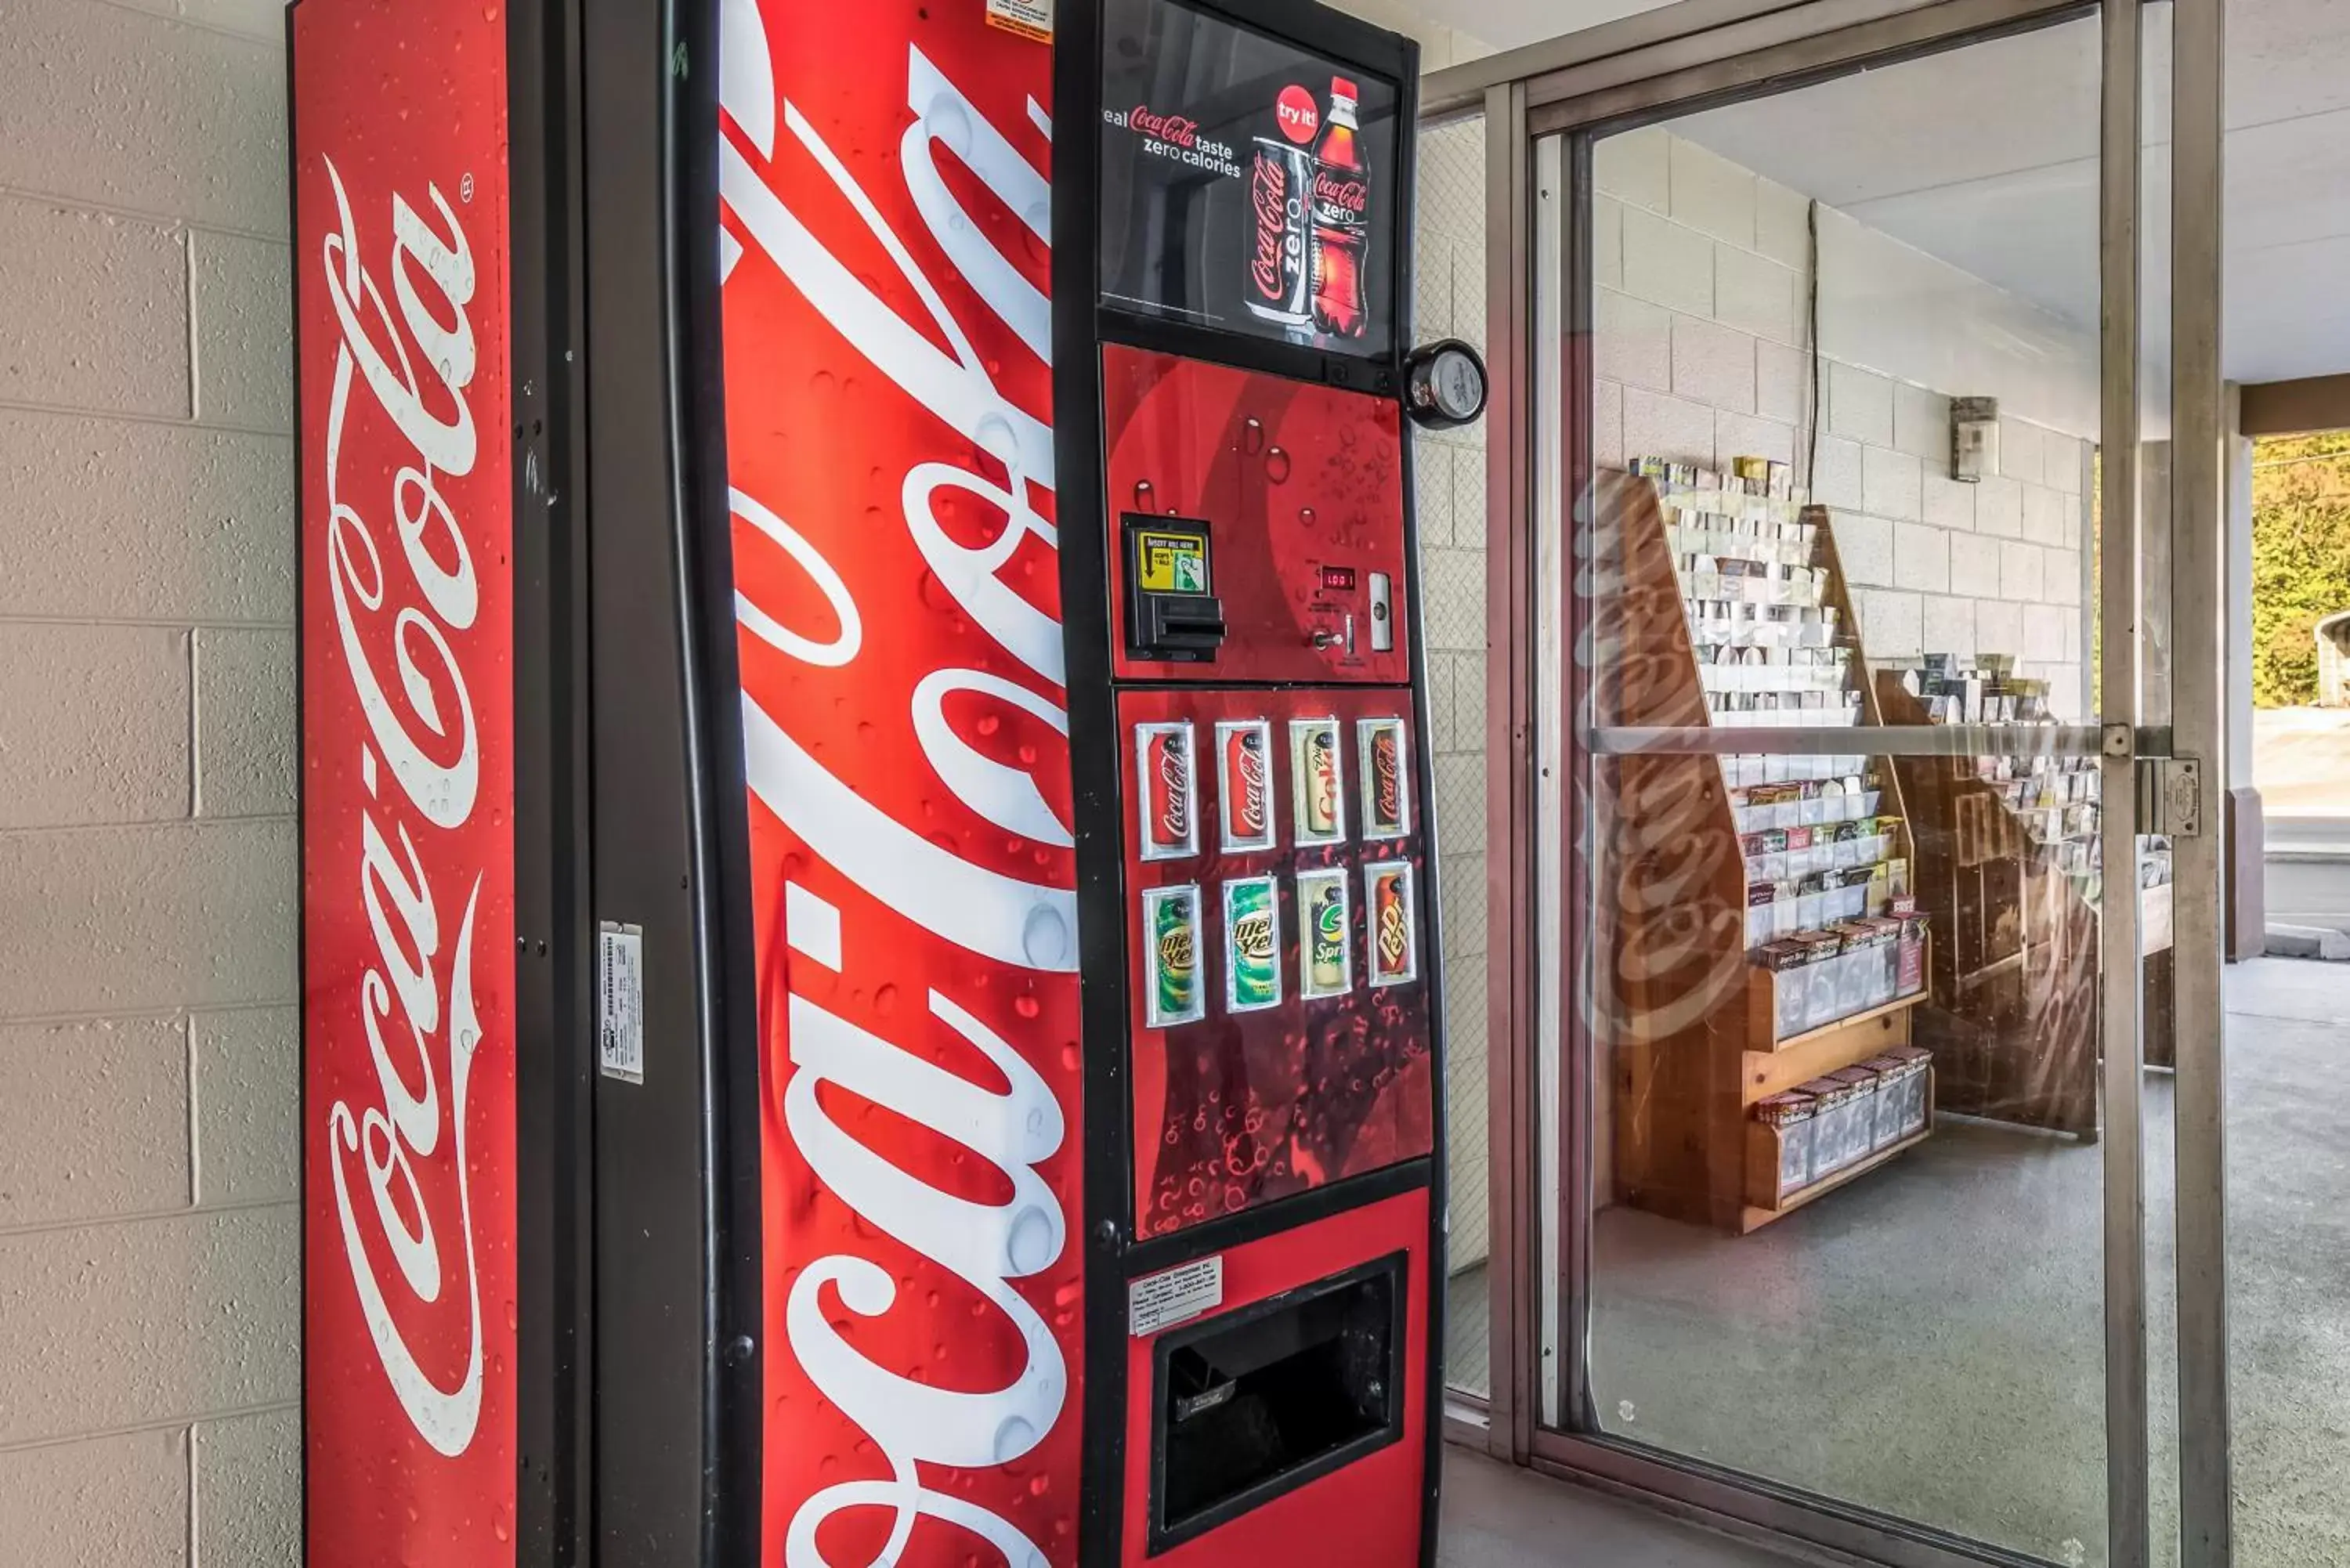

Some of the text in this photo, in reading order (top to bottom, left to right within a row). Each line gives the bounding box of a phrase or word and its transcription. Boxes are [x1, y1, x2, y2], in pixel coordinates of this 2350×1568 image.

[1104, 104, 1233, 160] eal Coca-Cola taste
[1278, 103, 1316, 127] try it!
[1144, 138, 1242, 179] zero calories
[1314, 172, 1367, 211] Coca-Cola
[1253, 150, 1285, 301] Coca-Cola
[1285, 197, 1302, 276] zero
[1323, 201, 1355, 224] zero
[324, 155, 483, 1457] Coca-Cola
[1161, 746, 1189, 837] Coca-Col
[1238, 742, 1267, 831] Coca-Col
